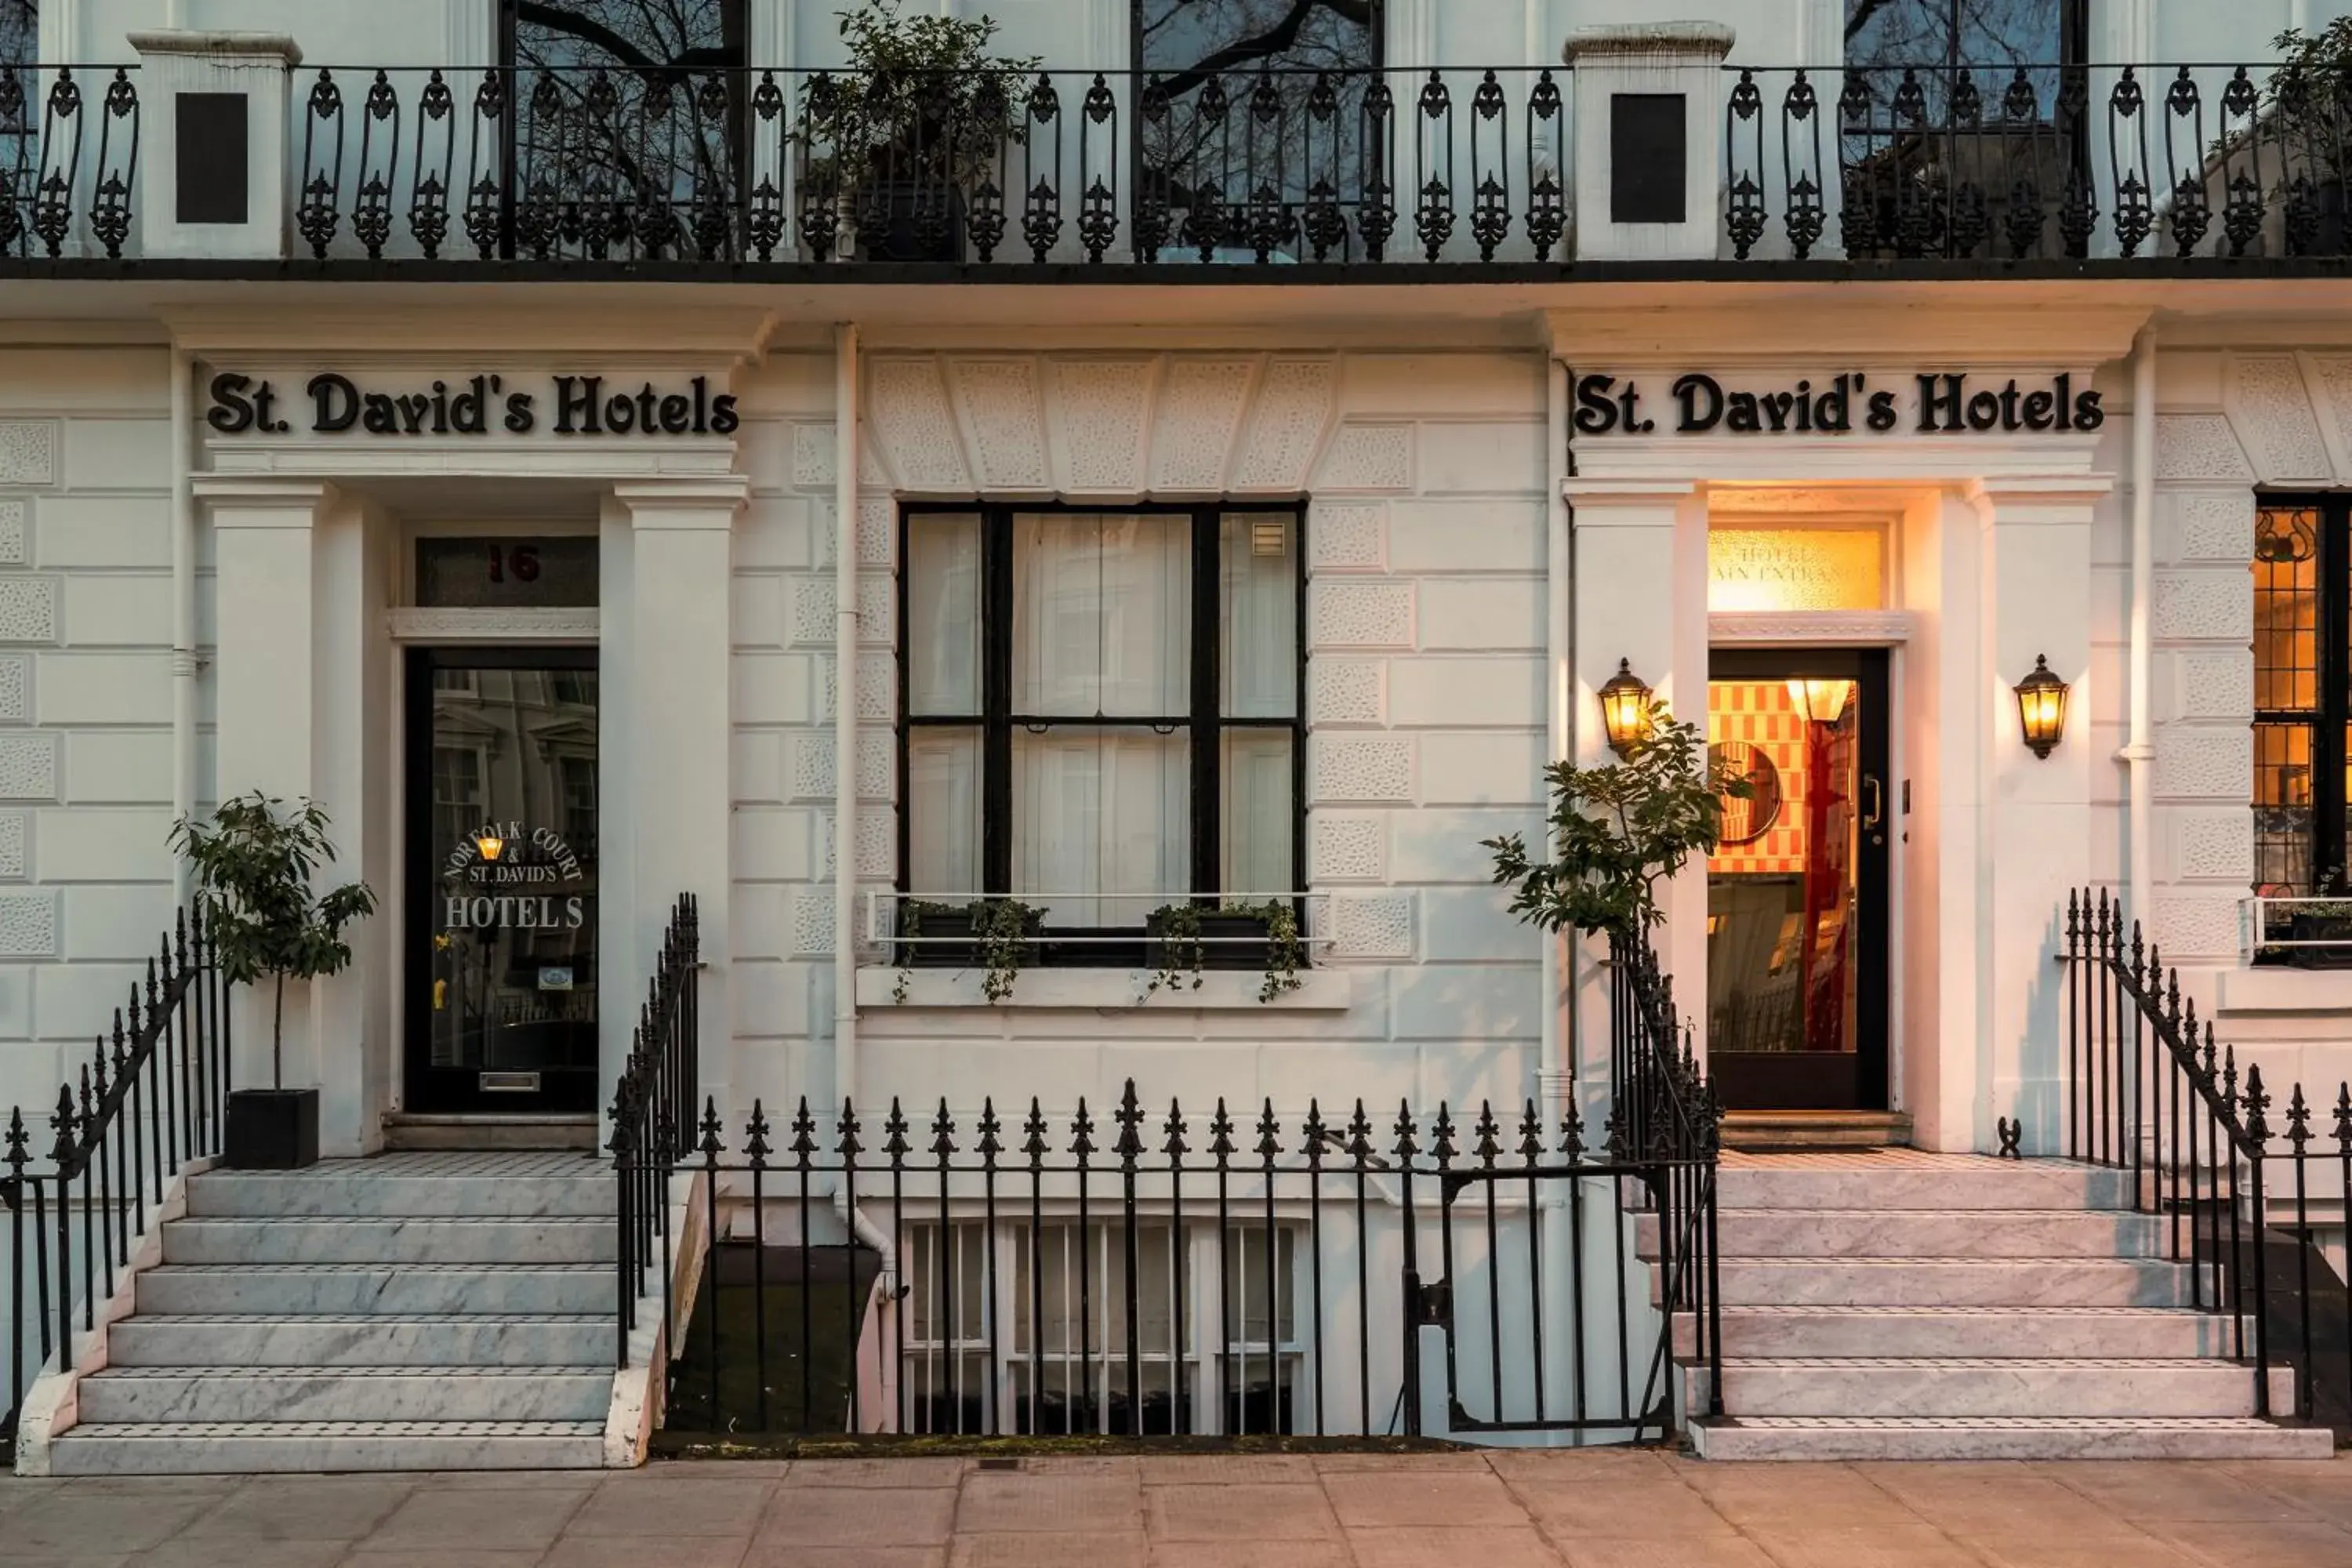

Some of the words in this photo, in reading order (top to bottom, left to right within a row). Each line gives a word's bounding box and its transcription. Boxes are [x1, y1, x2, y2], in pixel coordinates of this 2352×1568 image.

[207, 373, 289, 434] St.
[307, 373, 534, 434] David's
[552, 376, 739, 435] Hotels
[1573, 374, 1654, 434] St.
[1672, 373, 1896, 432] David's
[1915, 372, 2103, 431] Hotels
[488, 544, 540, 583] 16
[445, 821, 521, 879] NORFOLK
[532, 827, 583, 881] COURT
[508, 847, 519, 862] &
[496, 865, 557, 883] DAVID'S
[445, 895, 583, 928] HOTELS
